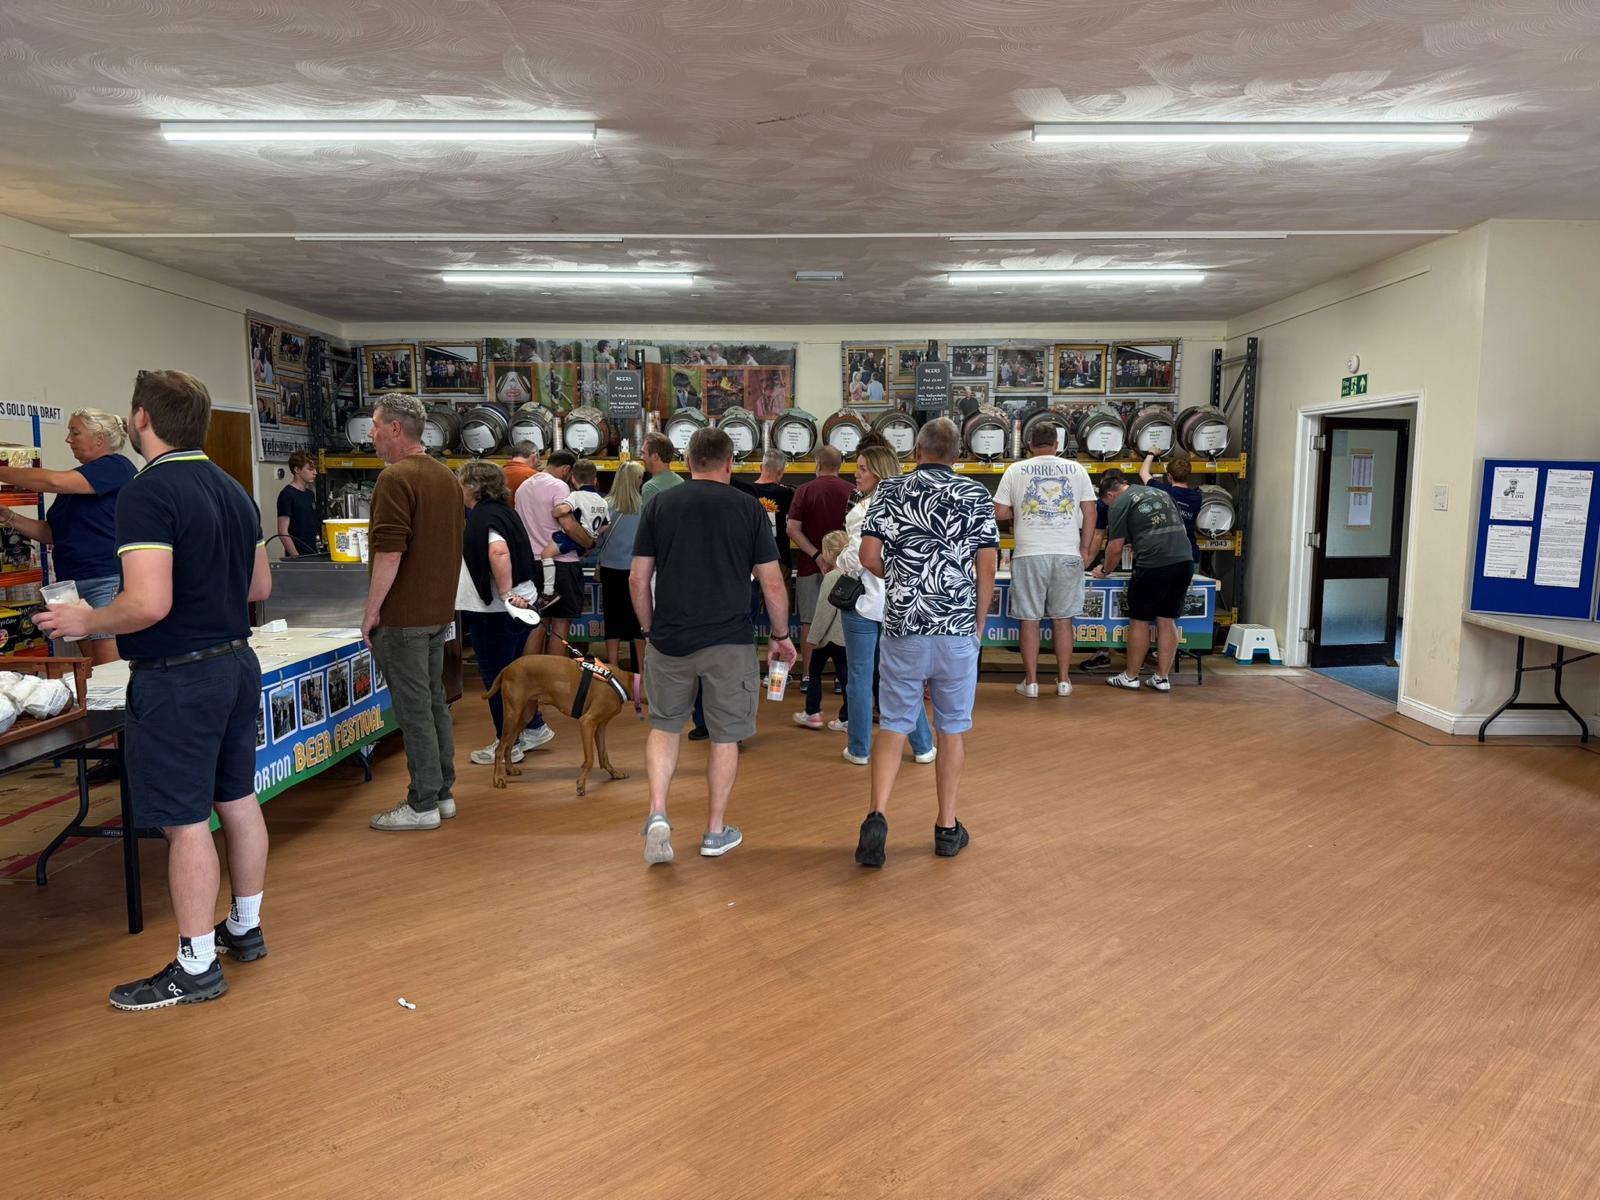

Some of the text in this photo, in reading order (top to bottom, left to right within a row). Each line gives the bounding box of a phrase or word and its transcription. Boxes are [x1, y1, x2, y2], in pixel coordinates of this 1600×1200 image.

[6, 403, 26, 416] GOLD
[27, 405, 39, 417] ON
[40, 406, 61, 419] DRAFT
[1020, 463, 1077, 476] SORRENTO
[581, 662, 611, 676] CASEY
[293, 729, 332, 773] BEER
[334, 703, 385, 752] FESTIVAL
